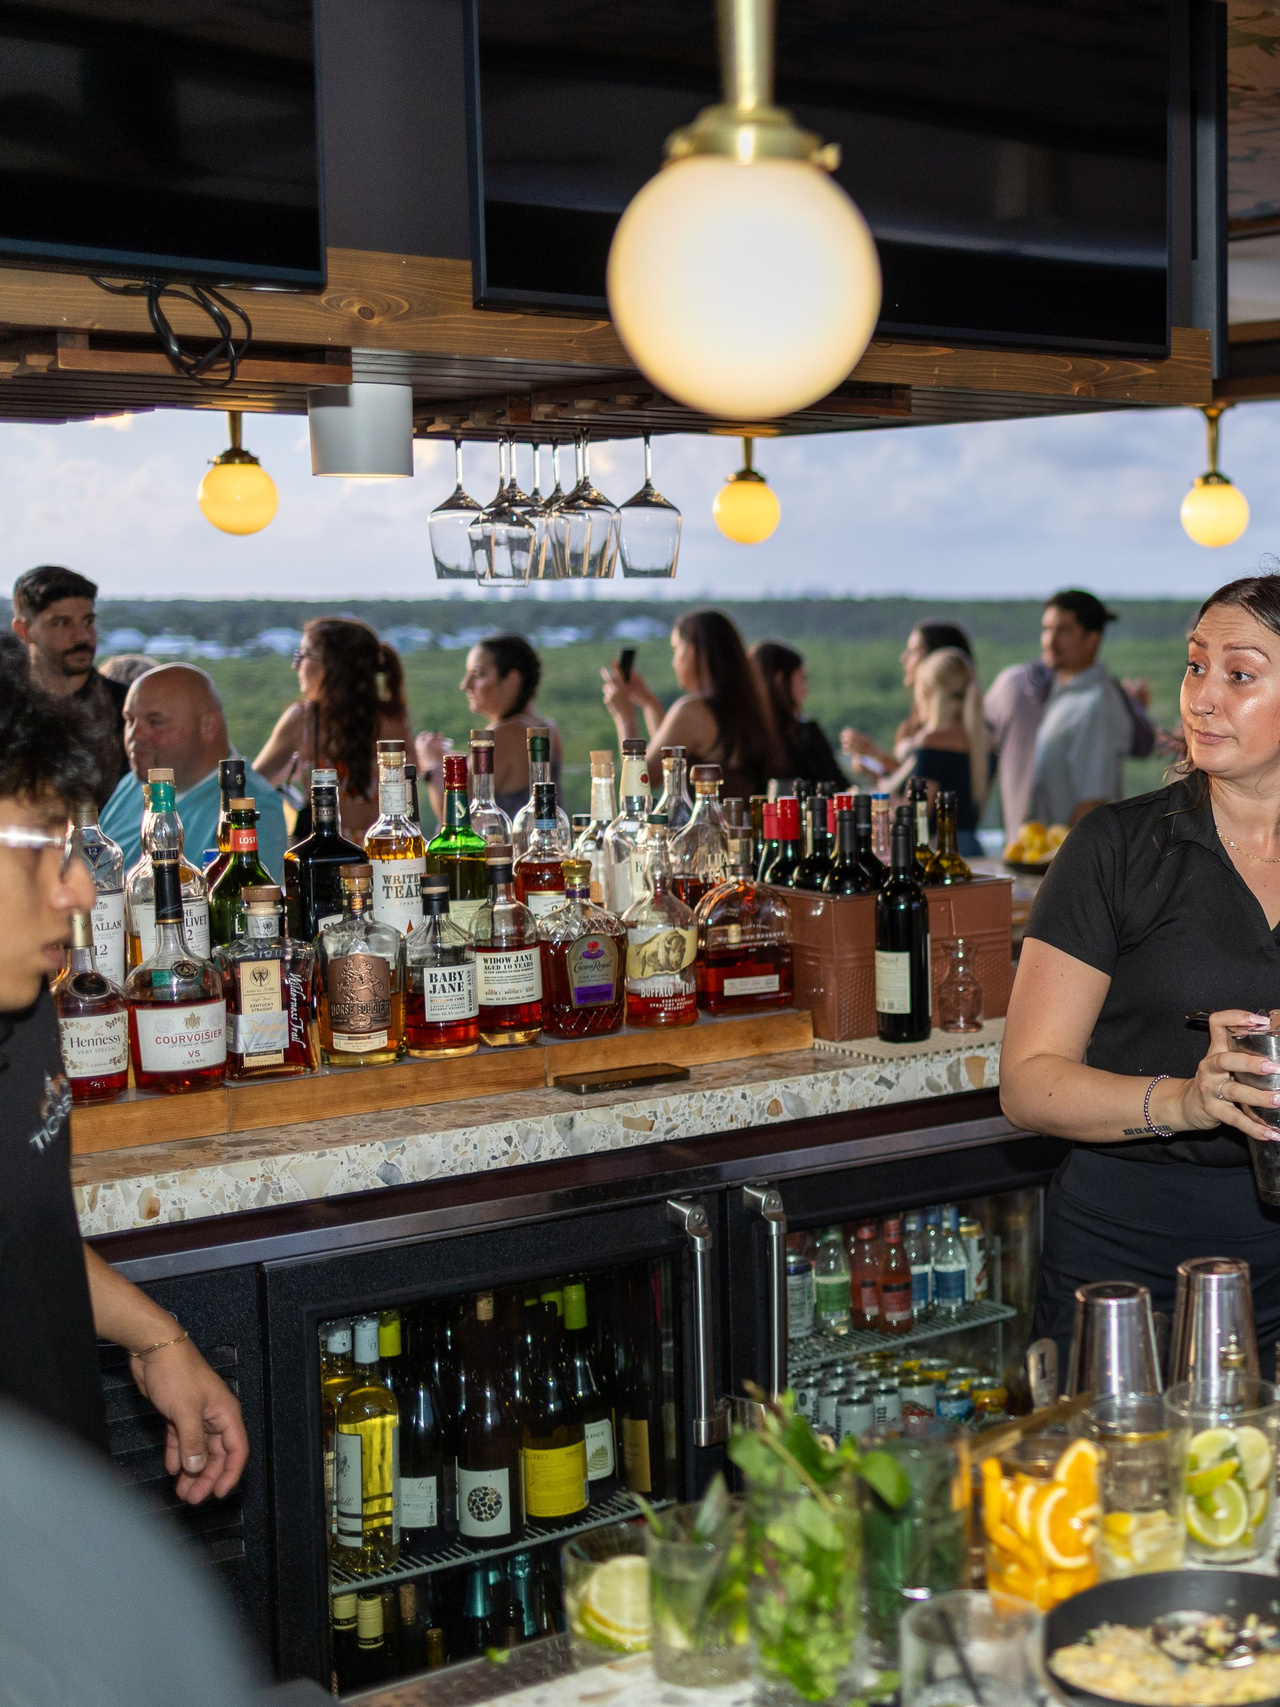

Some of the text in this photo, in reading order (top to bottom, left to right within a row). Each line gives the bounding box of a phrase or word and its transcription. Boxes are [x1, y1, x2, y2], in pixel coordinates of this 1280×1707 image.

[239, 836, 256, 845] LOST
[88, 847, 98, 856] 12
[382, 872, 425, 885] WRITE
[382, 884, 422, 899] TEAR
[93, 919, 123, 932] ALLAN
[185, 914, 207, 927] LIVET
[483, 953, 533, 965] WIDOW JANE
[514, 961, 534, 969] YEARS
[429, 970, 465, 984] BABY
[429, 981, 465, 995] JANE
[640, 983, 674, 998] BUFFALO
[70, 1034, 121, 1048] Hennessy
[155, 1028, 223, 1045] COURVOISIER
[188, 1049, 201, 1058] VS
